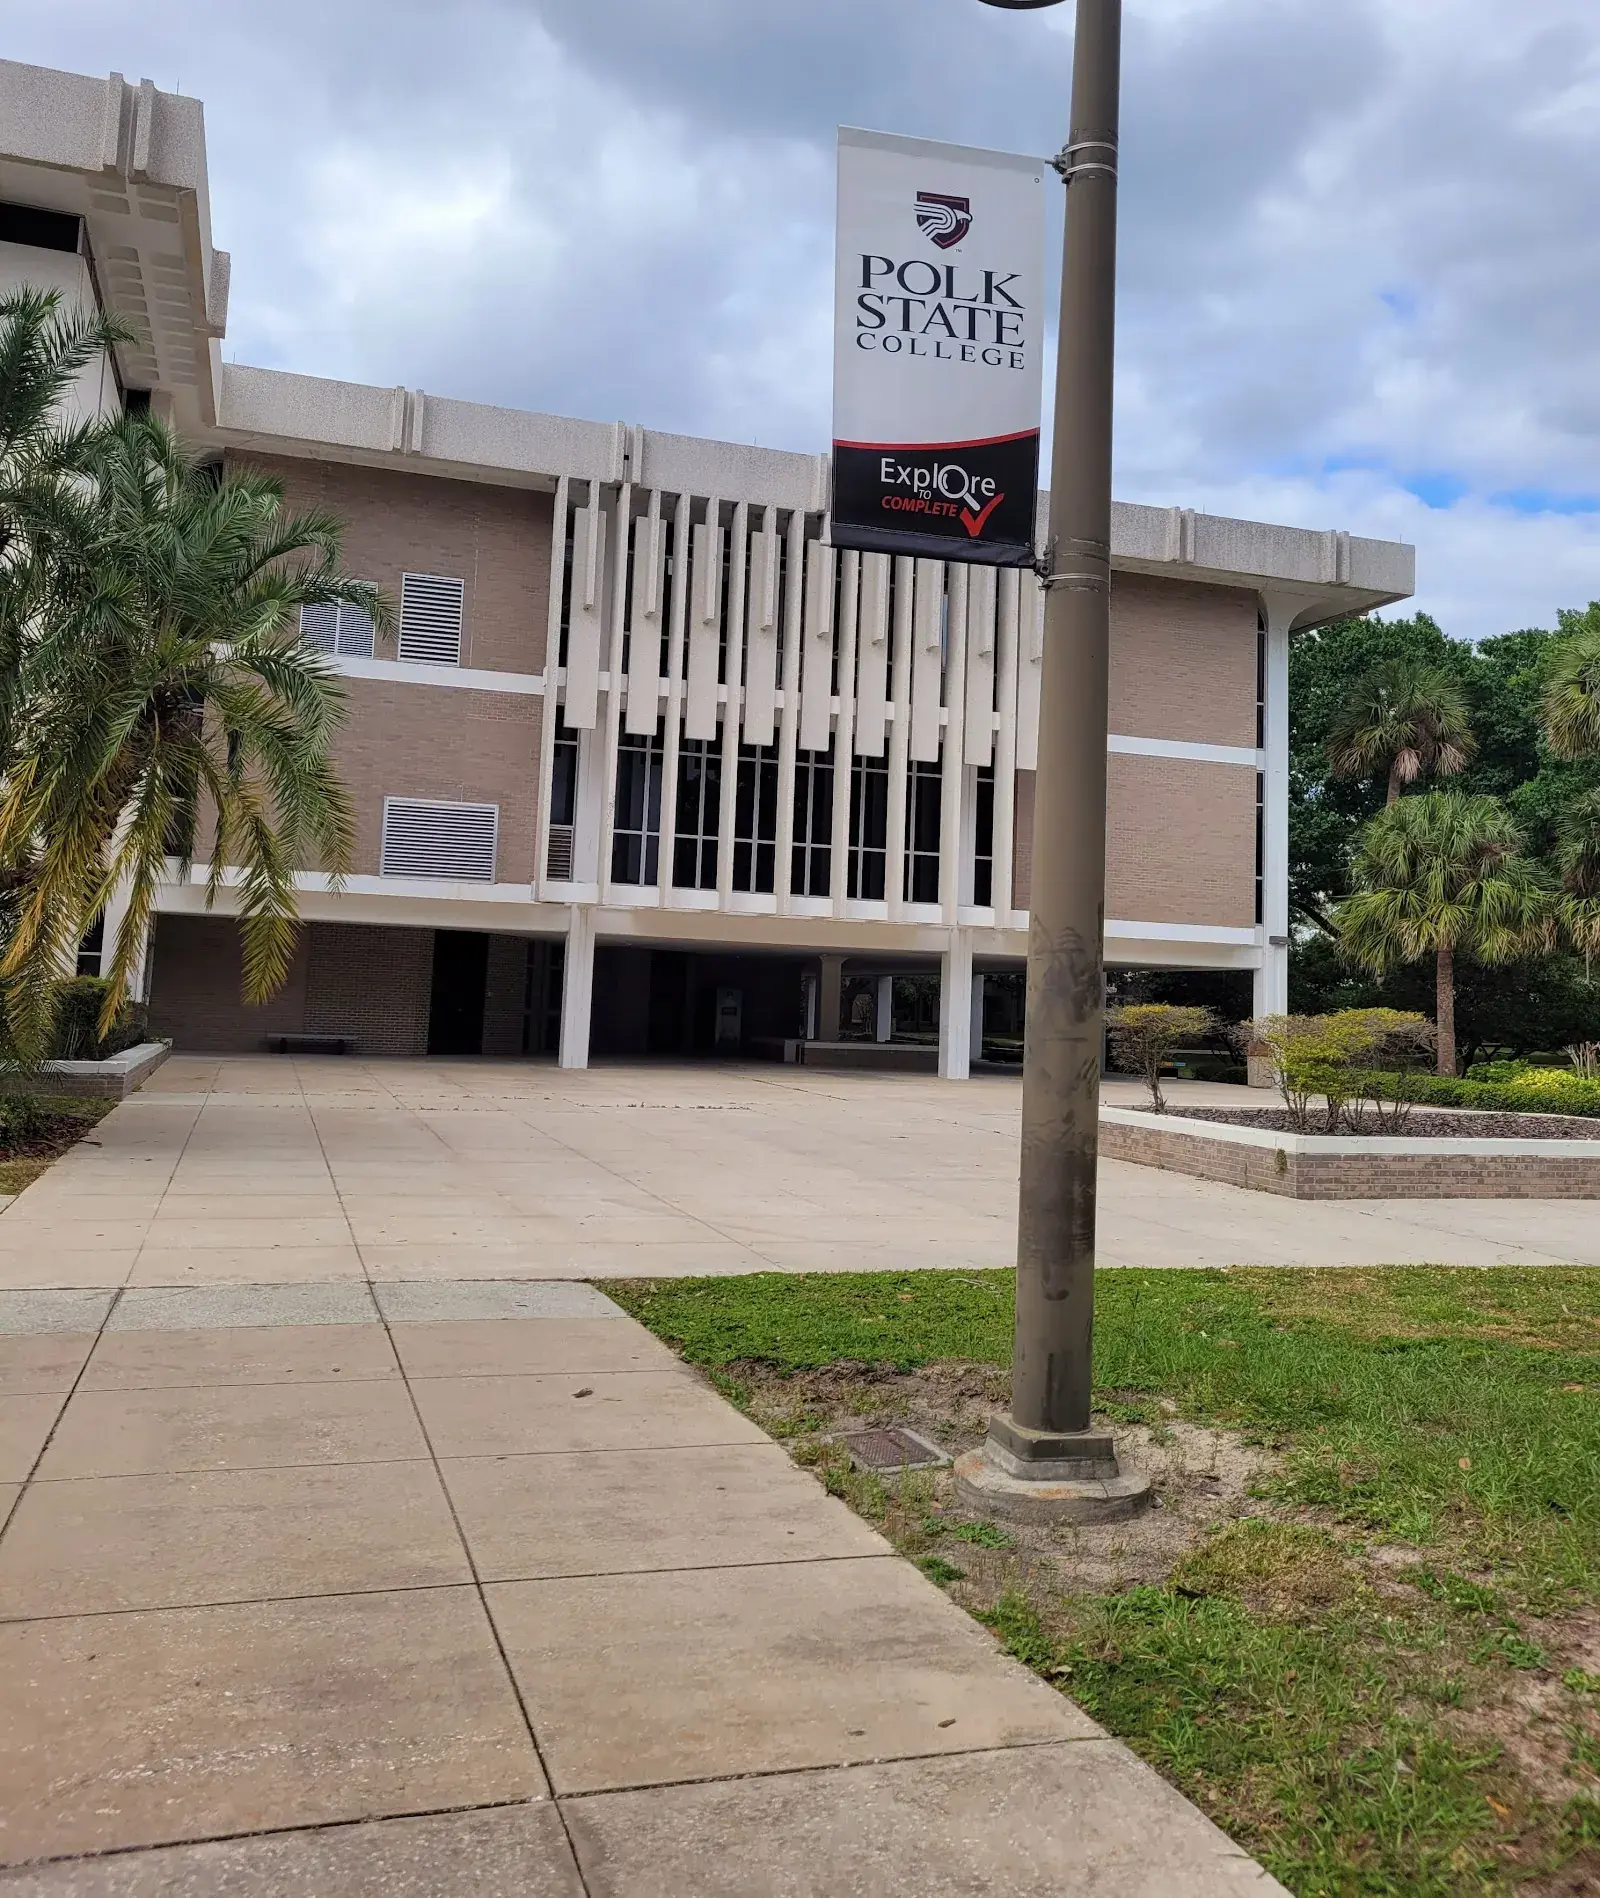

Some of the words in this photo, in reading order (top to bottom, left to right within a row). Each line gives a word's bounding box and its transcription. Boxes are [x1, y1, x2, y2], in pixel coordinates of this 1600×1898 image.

[857, 253, 1026, 309] POLK
[856, 293, 1025, 347] STATE
[856, 332, 1025, 369] COLLEGE
[881, 495, 958, 517] COMPLETE
[919, 489, 932, 499] TO
